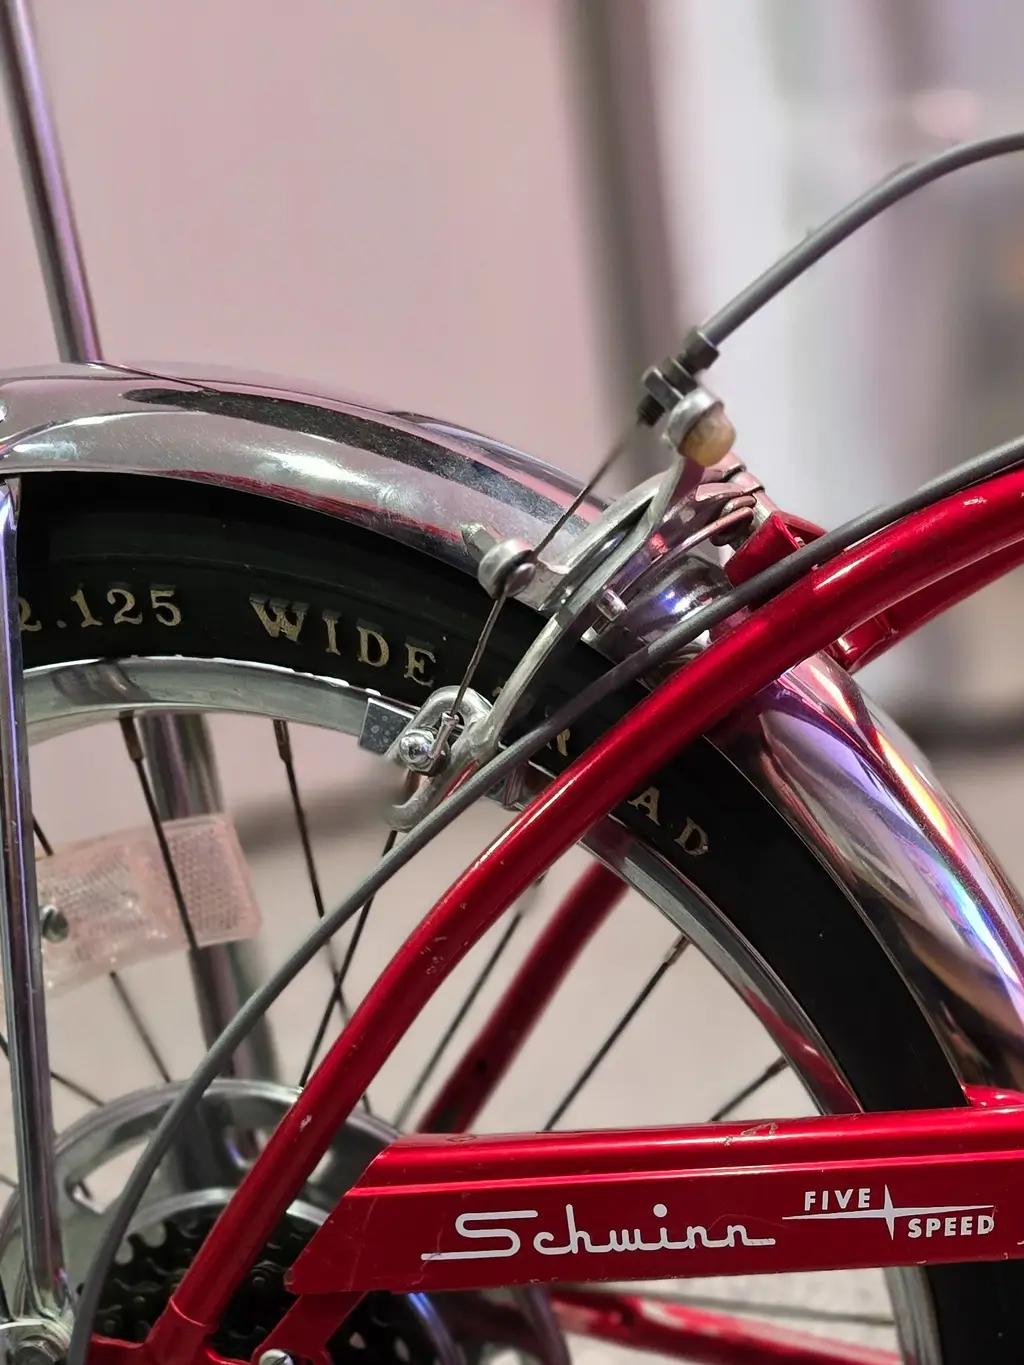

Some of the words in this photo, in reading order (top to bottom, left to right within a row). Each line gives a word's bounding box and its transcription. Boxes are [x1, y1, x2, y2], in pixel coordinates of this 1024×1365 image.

[249, 593, 437, 688] WIDE
[804, 1188, 871, 1211] FIVE
[421, 1203, 776, 1261] Schwinn
[907, 1214, 996, 1239] SPEED
